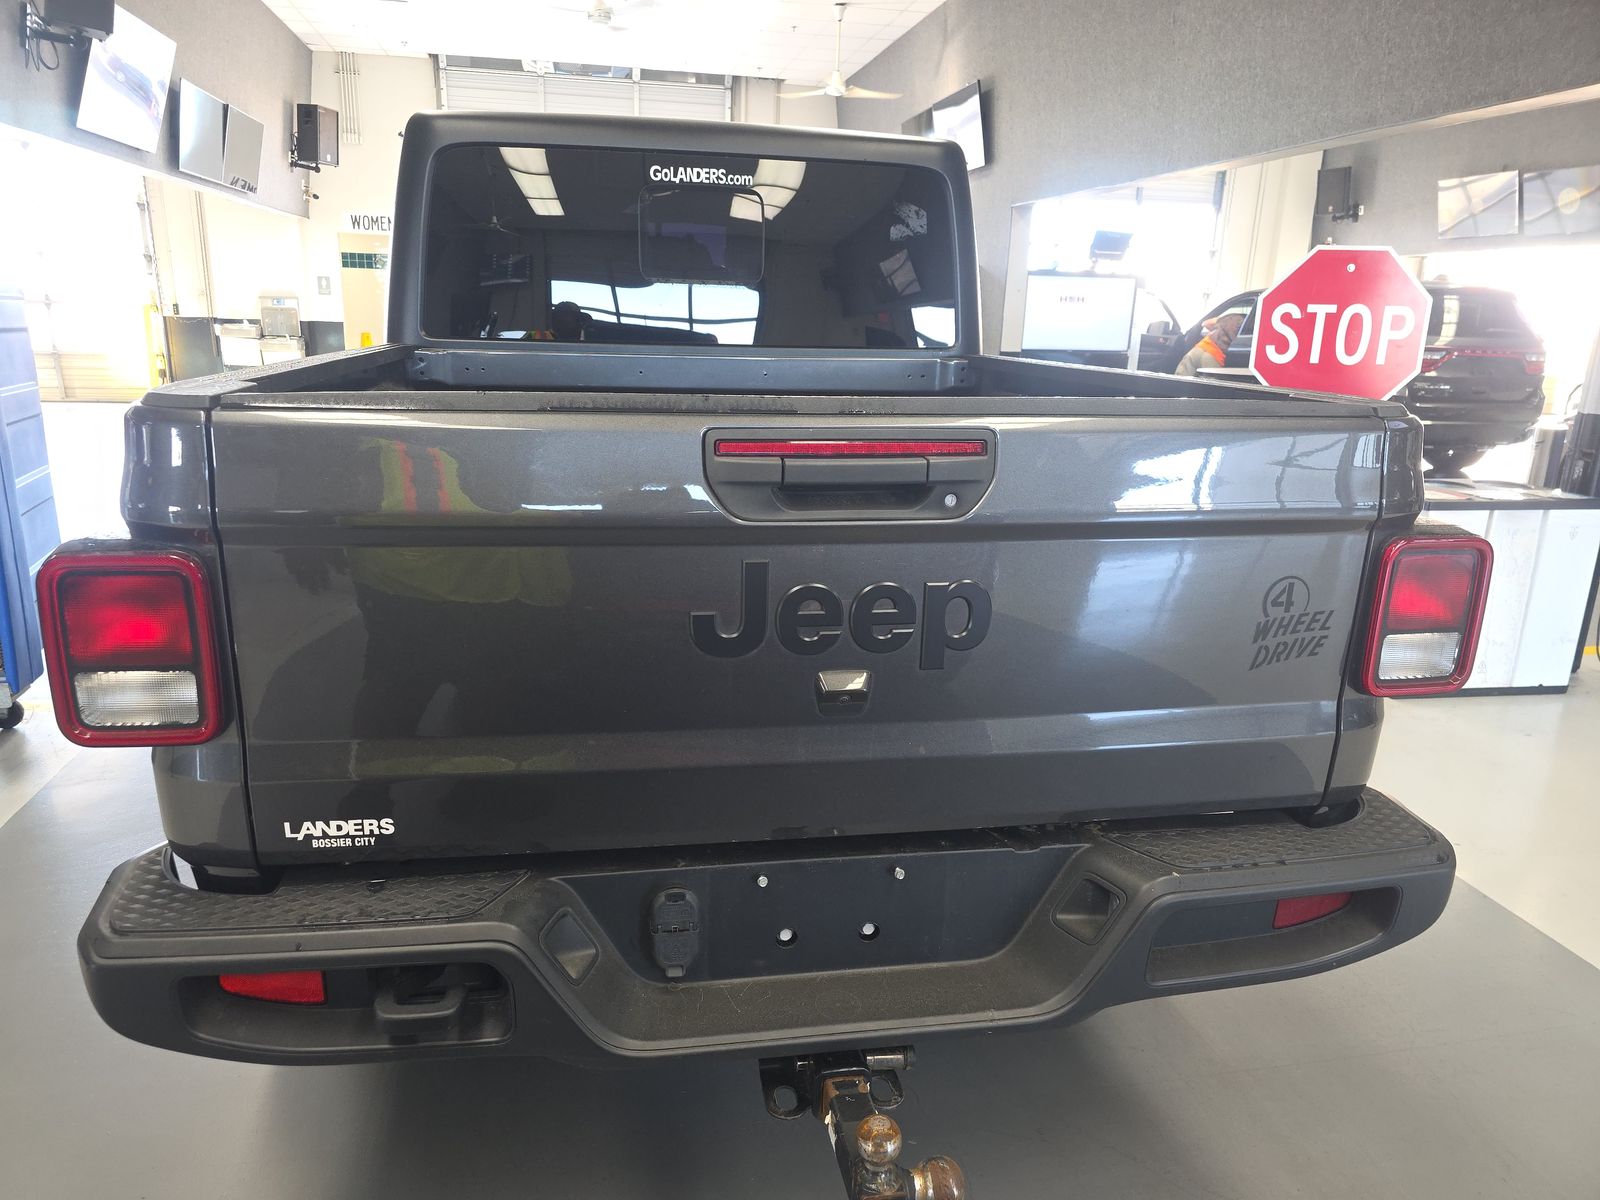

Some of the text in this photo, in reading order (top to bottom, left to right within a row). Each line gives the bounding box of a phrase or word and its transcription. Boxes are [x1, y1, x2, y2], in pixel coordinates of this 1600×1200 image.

[1265, 302, 1415, 366] STOP
[689, 559, 993, 671] Jeep
[1270, 582, 1295, 613] 4
[1252, 609, 1335, 644] WHEEL
[1248, 635, 1329, 671] DRIVE
[283, 818, 395, 840] LANDERS
[311, 837, 376, 848] BOSSIER CITY
